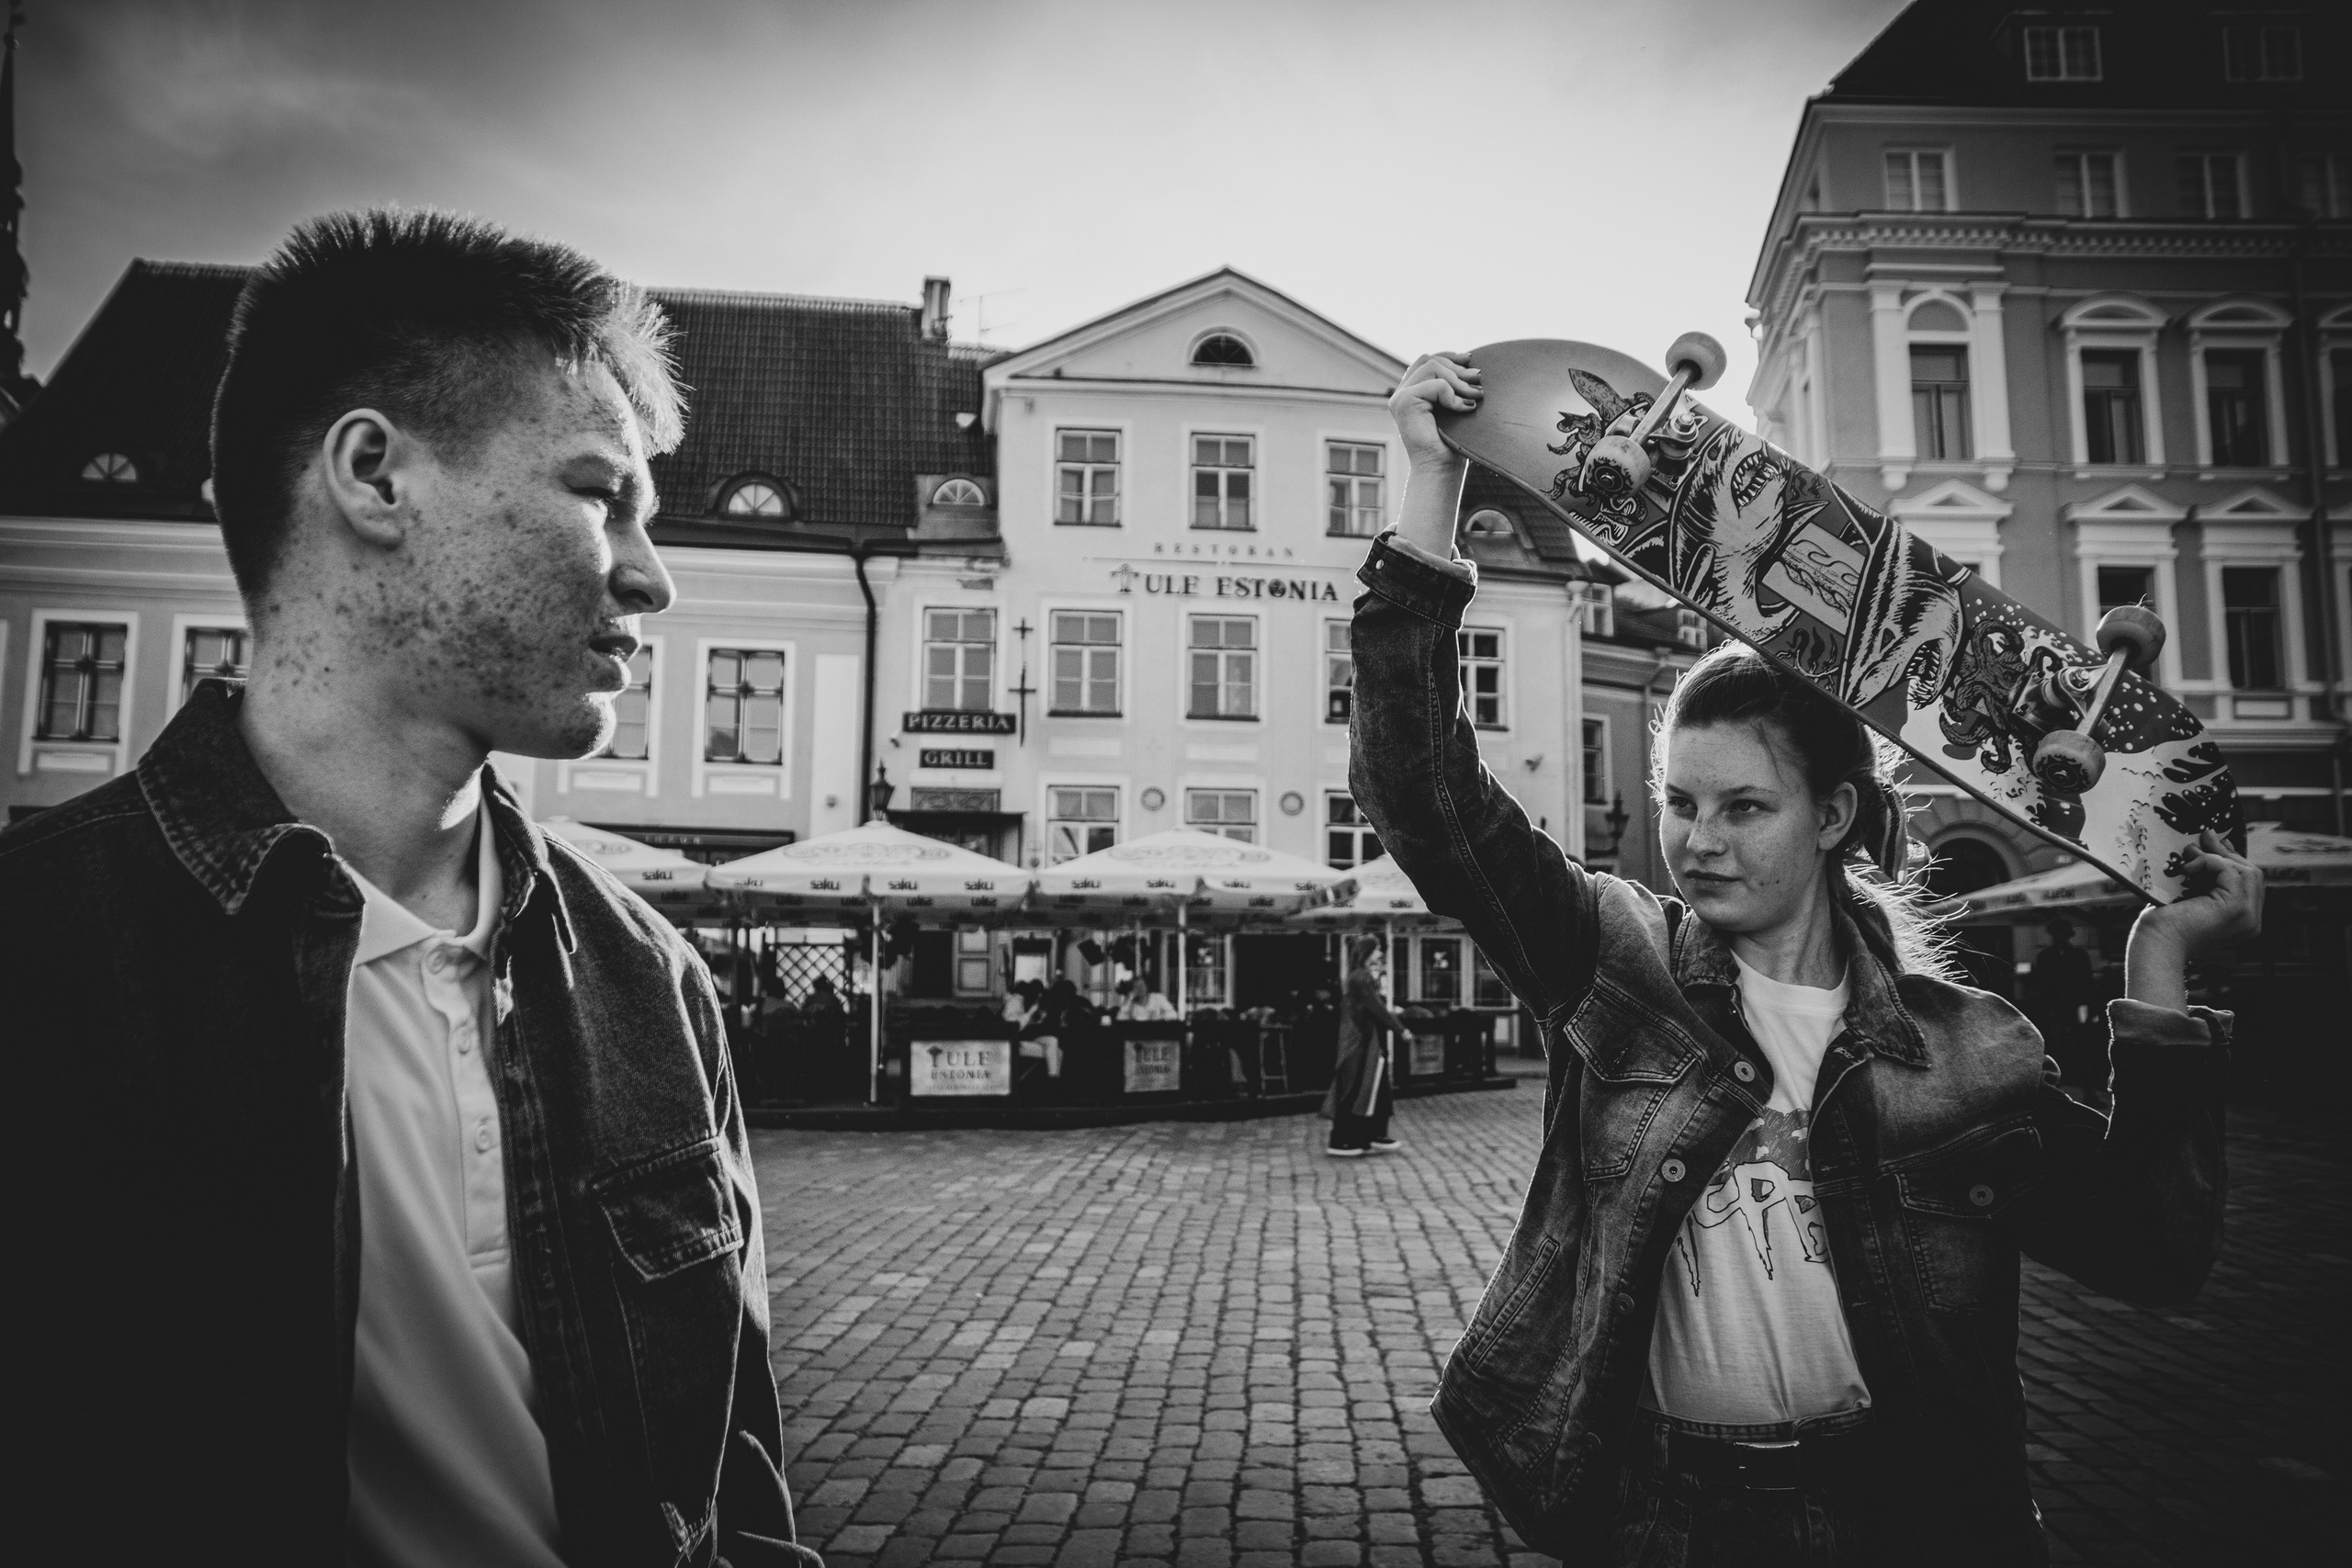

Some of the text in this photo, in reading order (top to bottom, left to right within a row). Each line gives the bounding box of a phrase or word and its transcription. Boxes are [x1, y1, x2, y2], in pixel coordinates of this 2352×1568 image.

[1155, 542, 1294, 557] RESTORAN
[1216, 576, 1339, 602] ESTONIA
[907, 714, 1011, 730] PIZZERIA
[924, 750, 988, 766] GRILL
[642, 870, 673, 881] saku
[809, 877, 841, 891] saku
[888, 877, 918, 891] saku
[965, 878, 994, 891] saku
[1071, 877, 1102, 889] saku
[1146, 877, 1176, 889] saku
